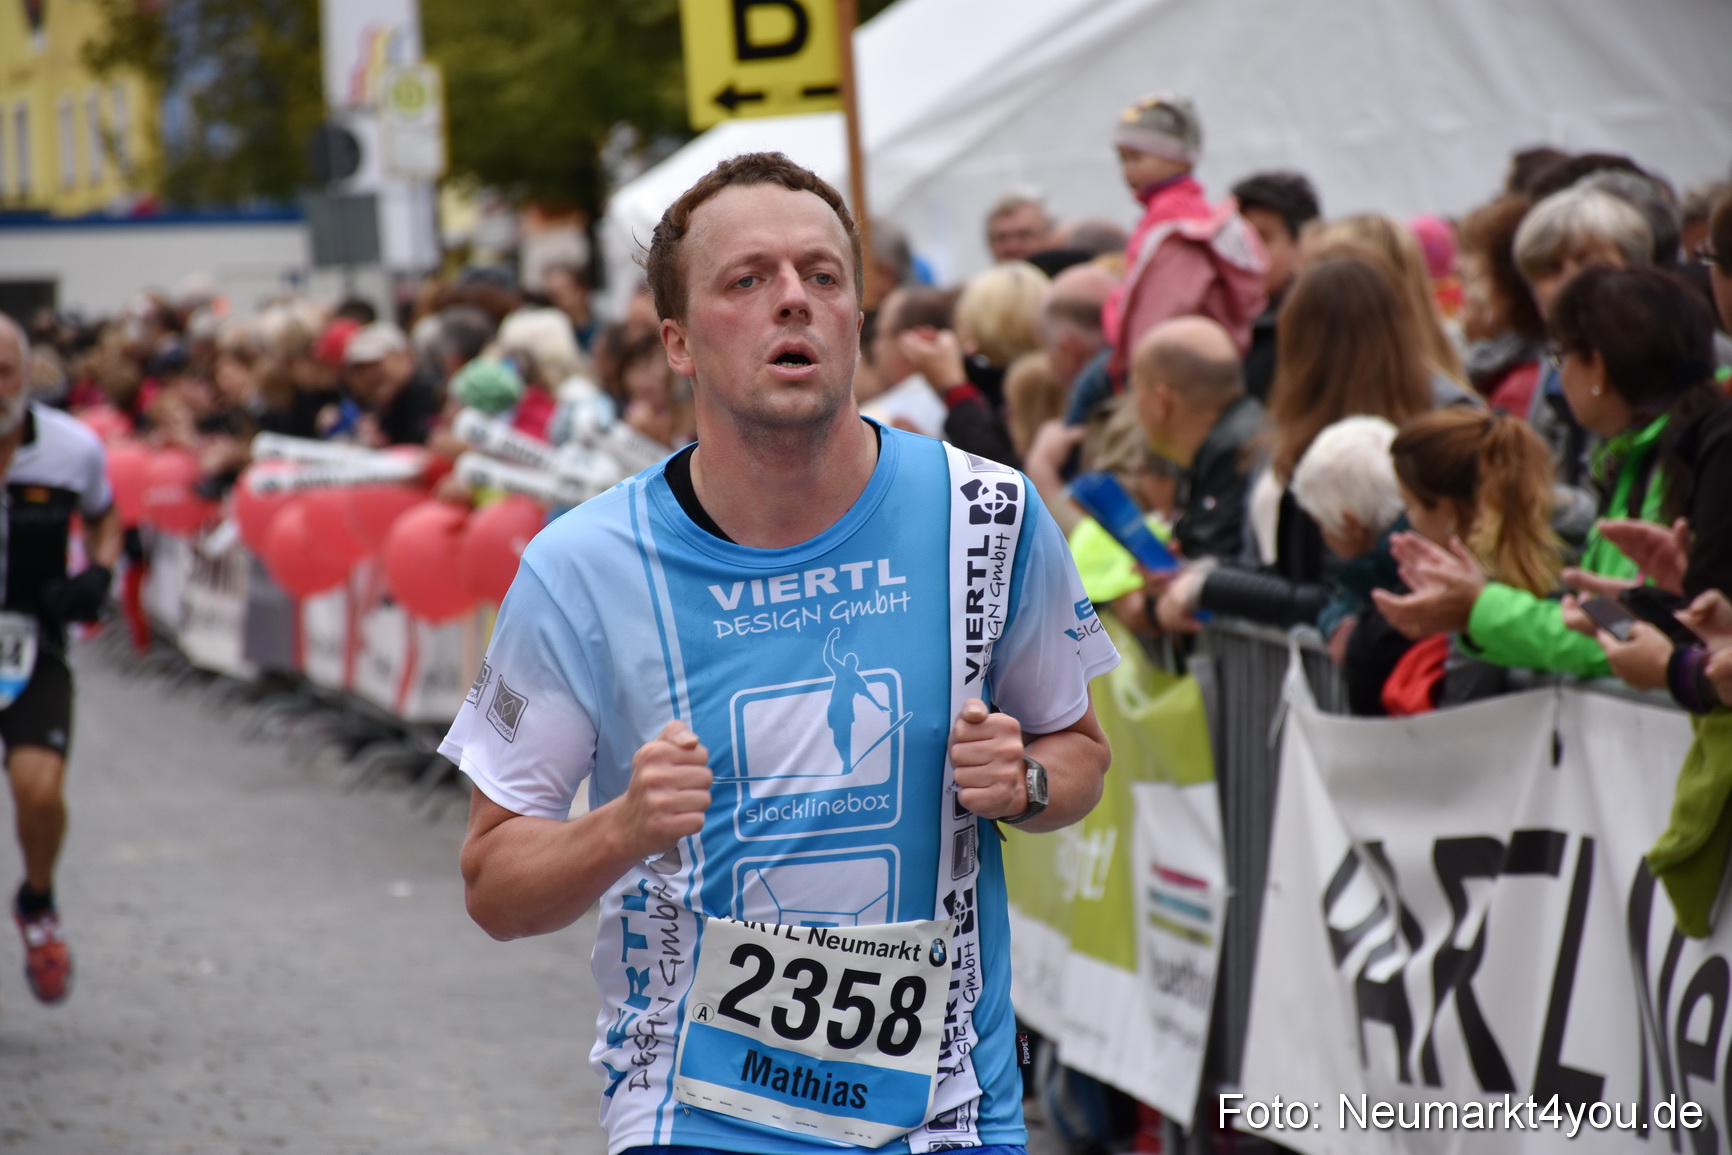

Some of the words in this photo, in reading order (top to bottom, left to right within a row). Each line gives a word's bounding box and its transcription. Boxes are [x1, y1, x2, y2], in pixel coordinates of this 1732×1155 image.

[733, 0, 809, 61] D
[708, 558, 907, 611] VIERTL
[989, 532, 1011, 598] GmbH
[713, 604, 821, 639] DESIGN
[829, 590, 911, 624] GmbH
[964, 535, 990, 685] VIERTL
[746, 793, 890, 823] slacklinebox
[650, 884, 685, 986] GmbH
[807, 927, 922, 962] Neumarkt
[601, 878, 652, 1098] VERTL
[717, 943, 927, 1057] 2358
[961, 941, 980, 1004] GmbH
[628, 997, 675, 1092] DESGN
[740, 1050, 868, 1110] Mathias
